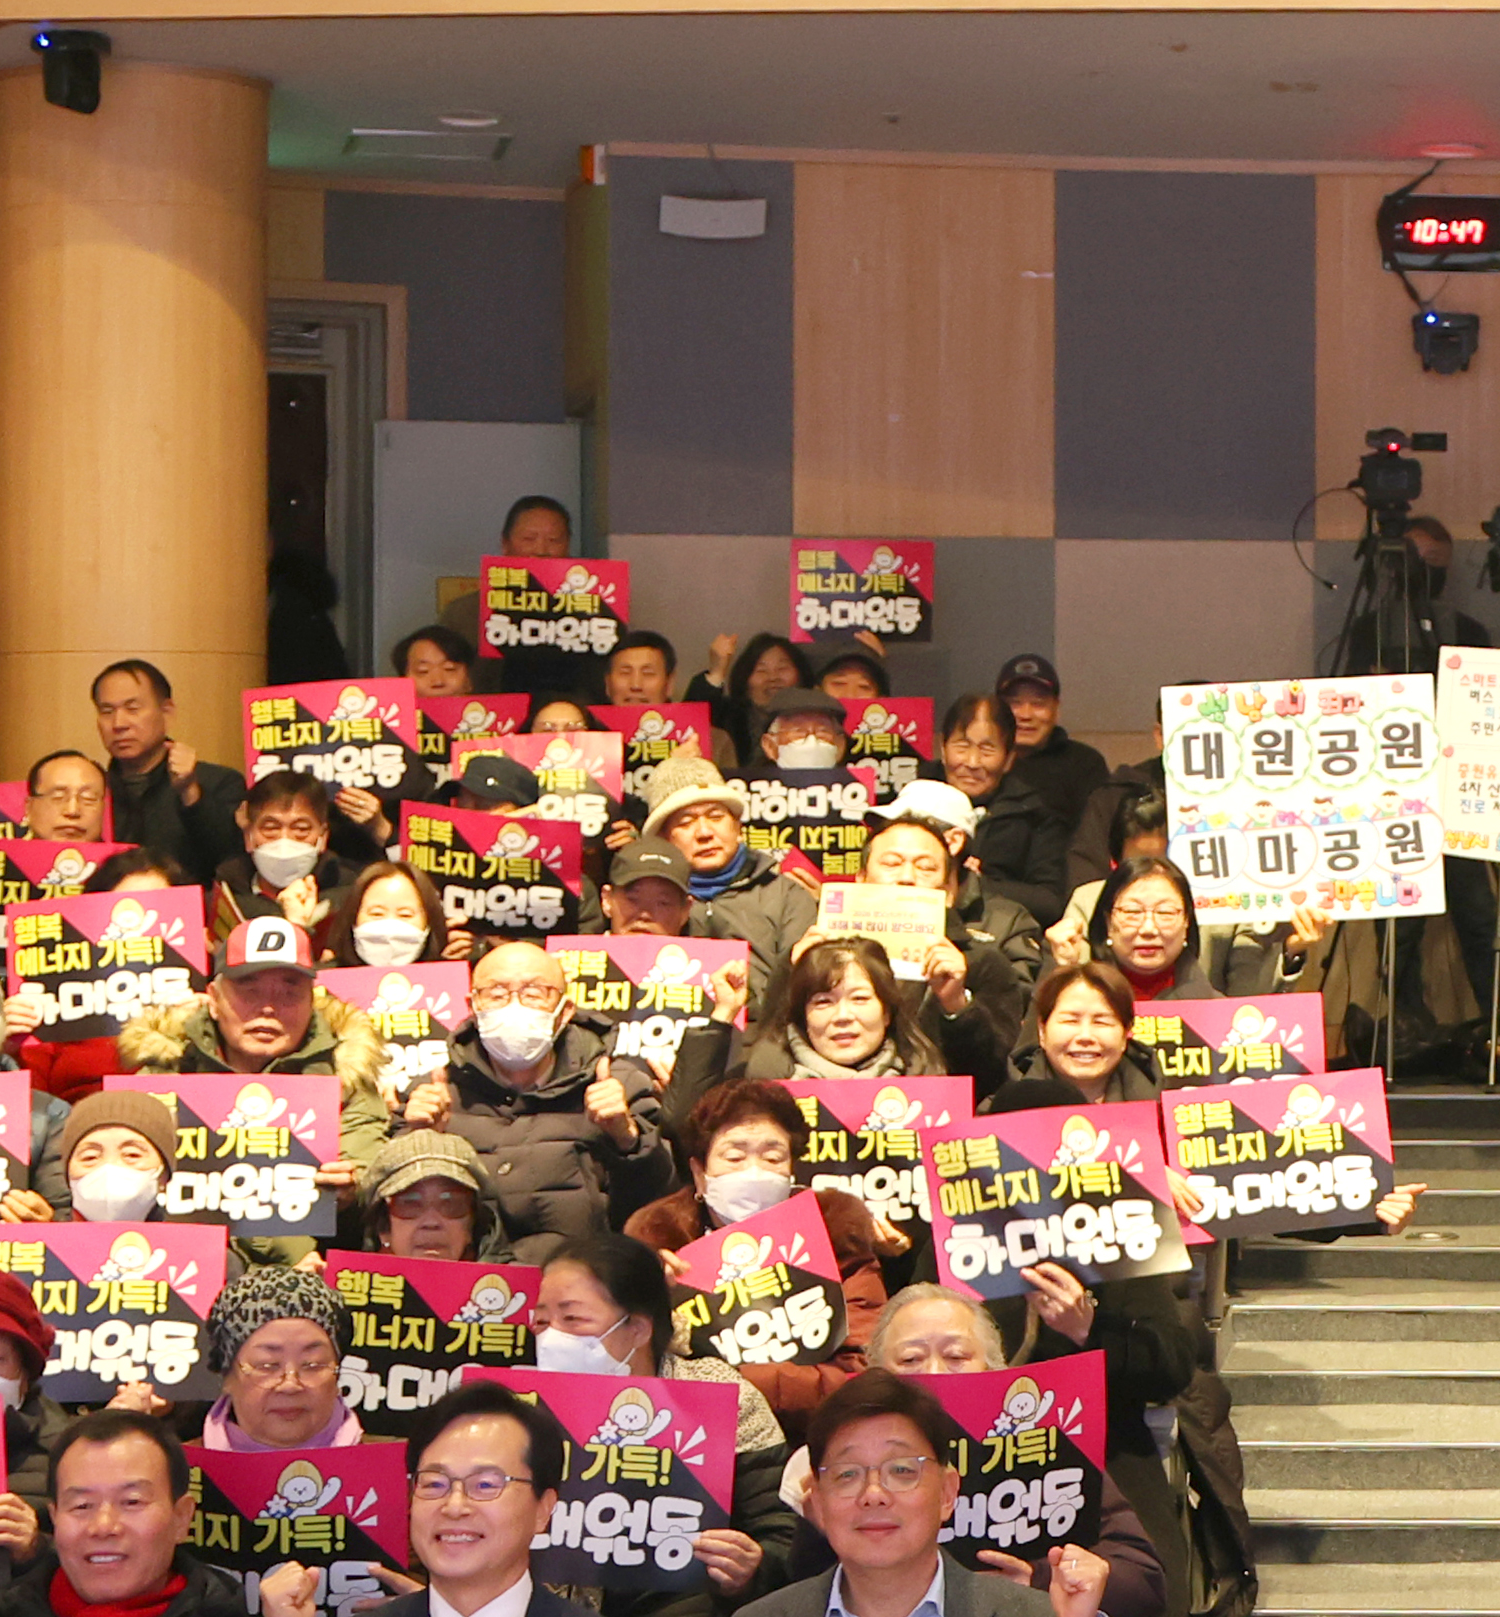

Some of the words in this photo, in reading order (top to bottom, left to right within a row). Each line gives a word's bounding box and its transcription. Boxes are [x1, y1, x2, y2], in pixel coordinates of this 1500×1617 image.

[1411, 218, 1487, 245] 10:47
[487, 567, 529, 589] 행복
[486, 590, 548, 613] 에너지
[552, 592, 600, 615] 가득!
[485, 613, 619, 654] 하대원동
[1182, 720, 1424, 781] 대원공원
[1189, 820, 1427, 879] 테마공원
[13, 913, 64, 944] 행복
[14, 941, 91, 977] 에너지
[97, 936, 163, 967] 가득!
[1172, 1100, 1235, 1137] 행복
[933, 1136, 1001, 1180] 행복
[1177, 1128, 1268, 1172] 에너지
[1273, 1121, 1344, 1158] 가득!
[938, 1171, 1043, 1218] 에너지
[1050, 1160, 1125, 1198] 가득!
[1189, 1155, 1378, 1225] 하대원동
[943, 1198, 1164, 1284] 하대원동
